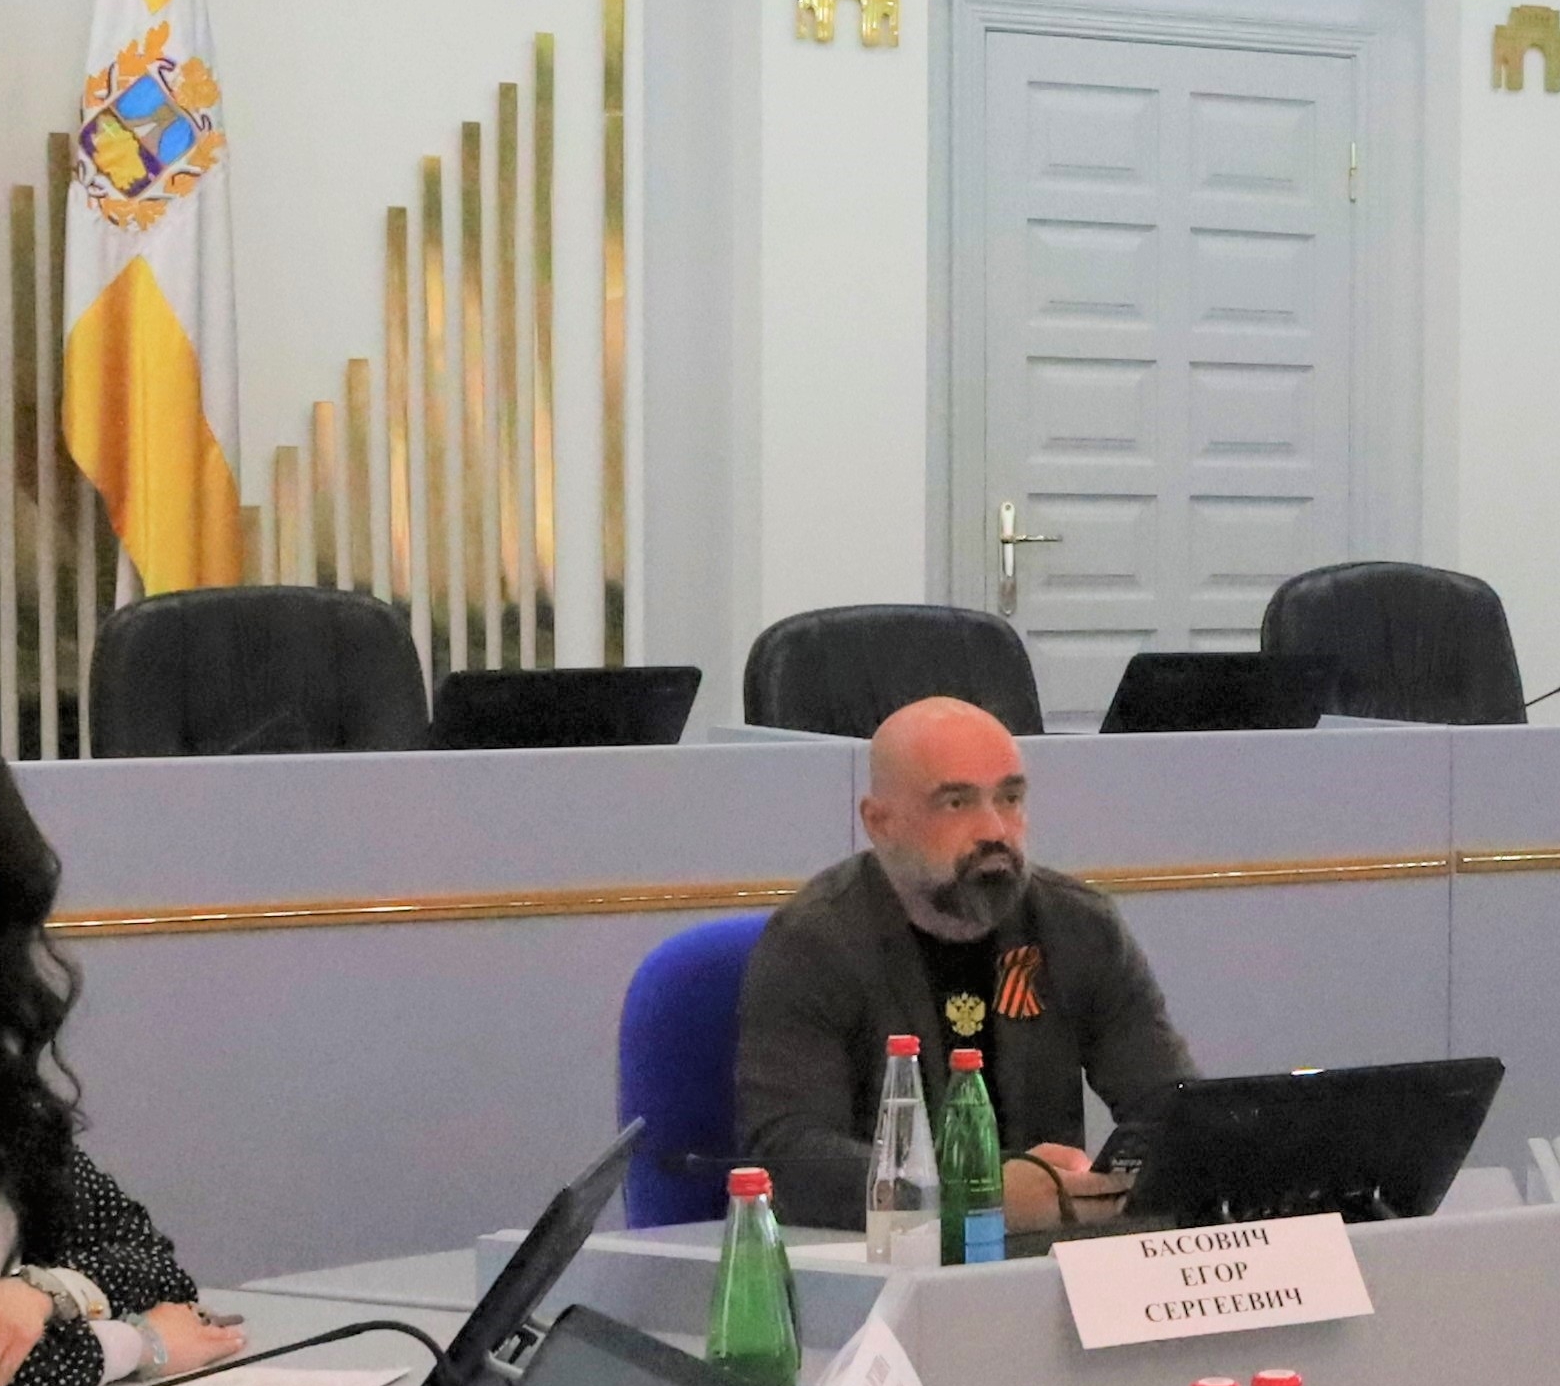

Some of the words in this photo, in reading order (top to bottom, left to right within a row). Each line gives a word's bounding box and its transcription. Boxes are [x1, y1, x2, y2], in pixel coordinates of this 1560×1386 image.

[1140, 1227, 1271, 1258] БАСОВИЧ
[1180, 1261, 1248, 1287] ЕГОР
[1144, 1287, 1303, 1323] СЕРГЕЕВИЧ
